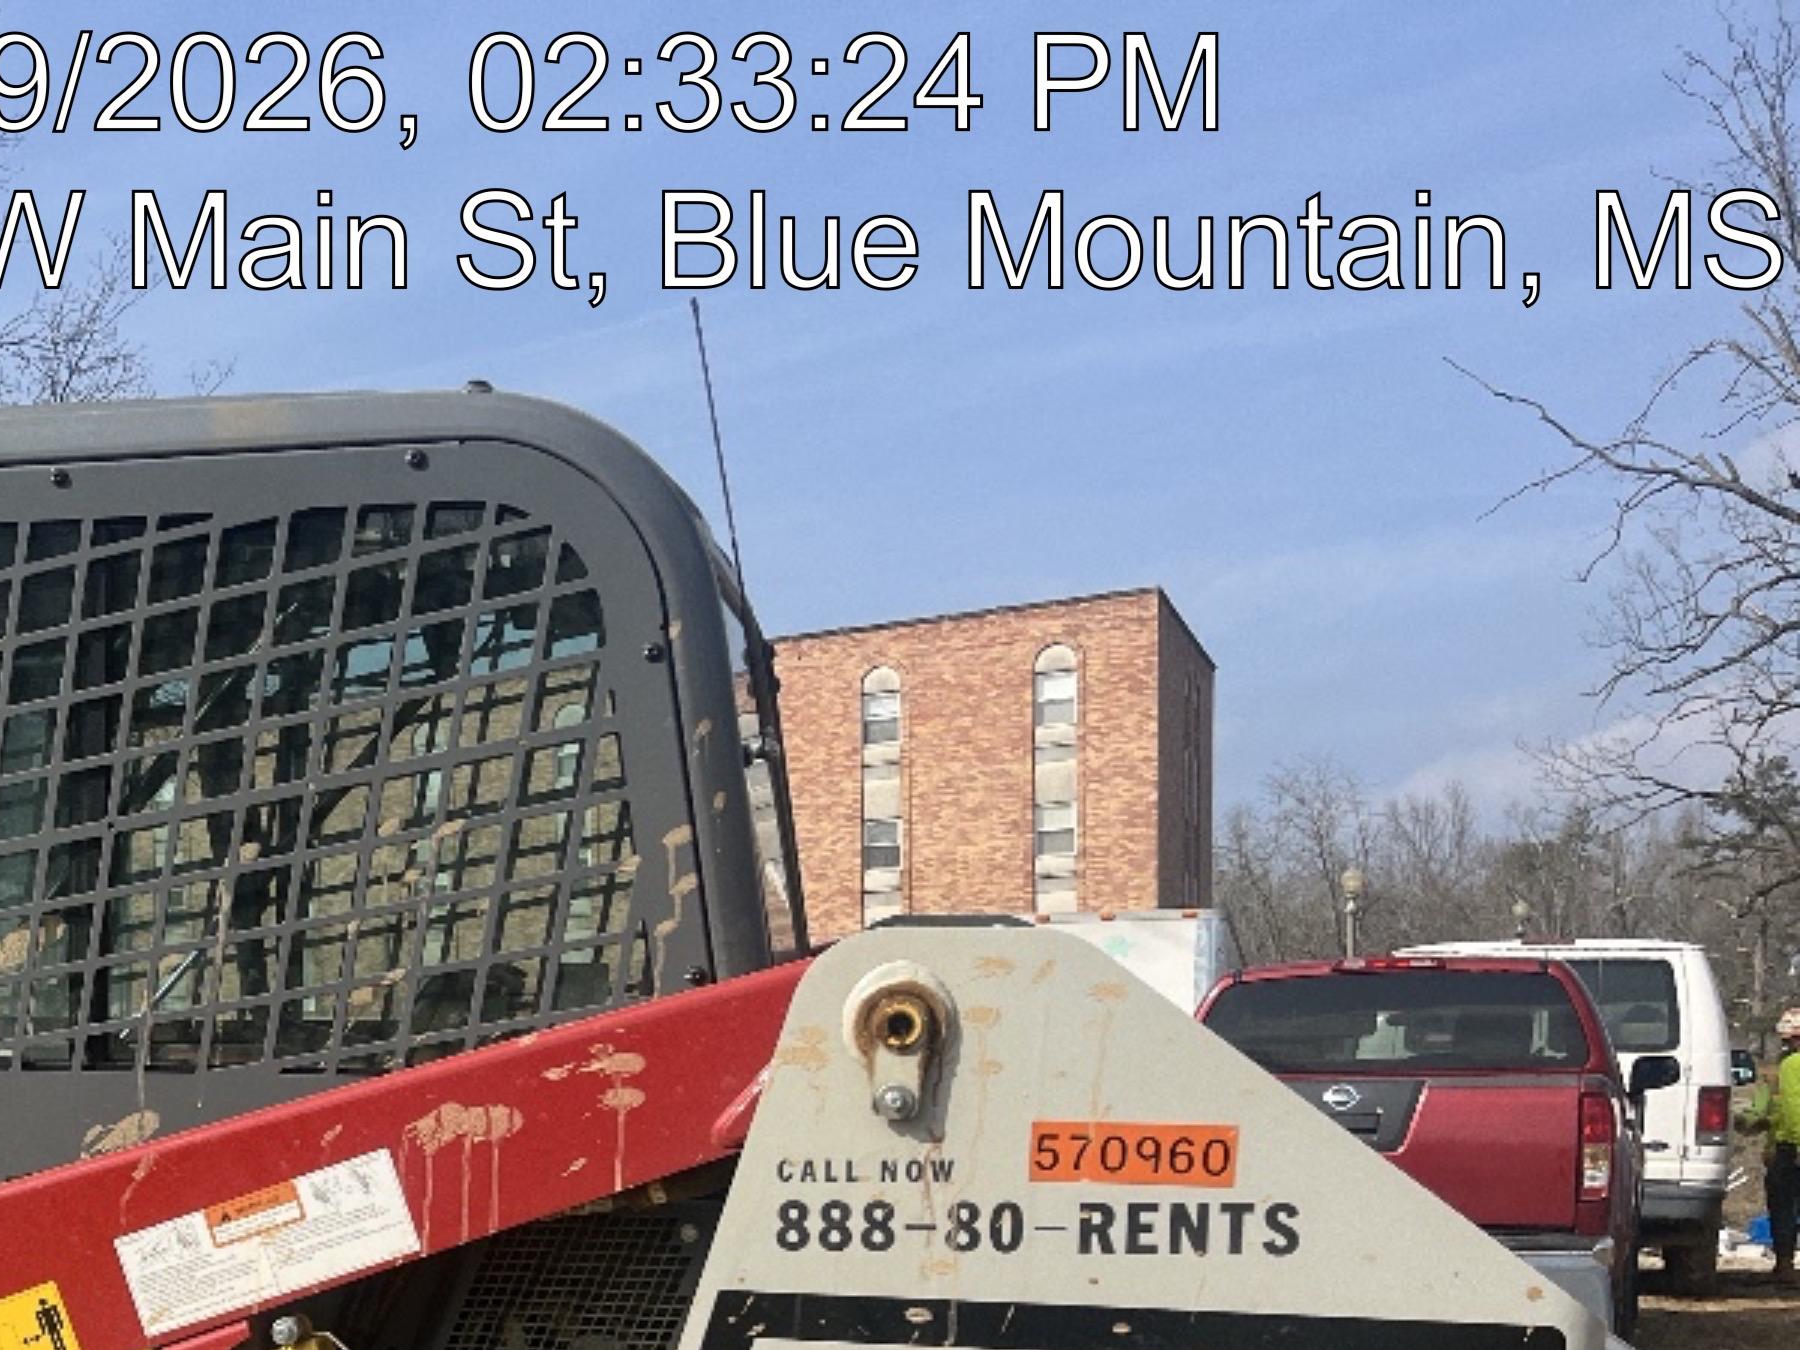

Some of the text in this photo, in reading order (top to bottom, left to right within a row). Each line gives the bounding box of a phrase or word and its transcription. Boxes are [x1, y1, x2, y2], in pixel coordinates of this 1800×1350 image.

[776, 1158, 955, 1184] CALL NOW
[1033, 1132, 1232, 1178] 570960
